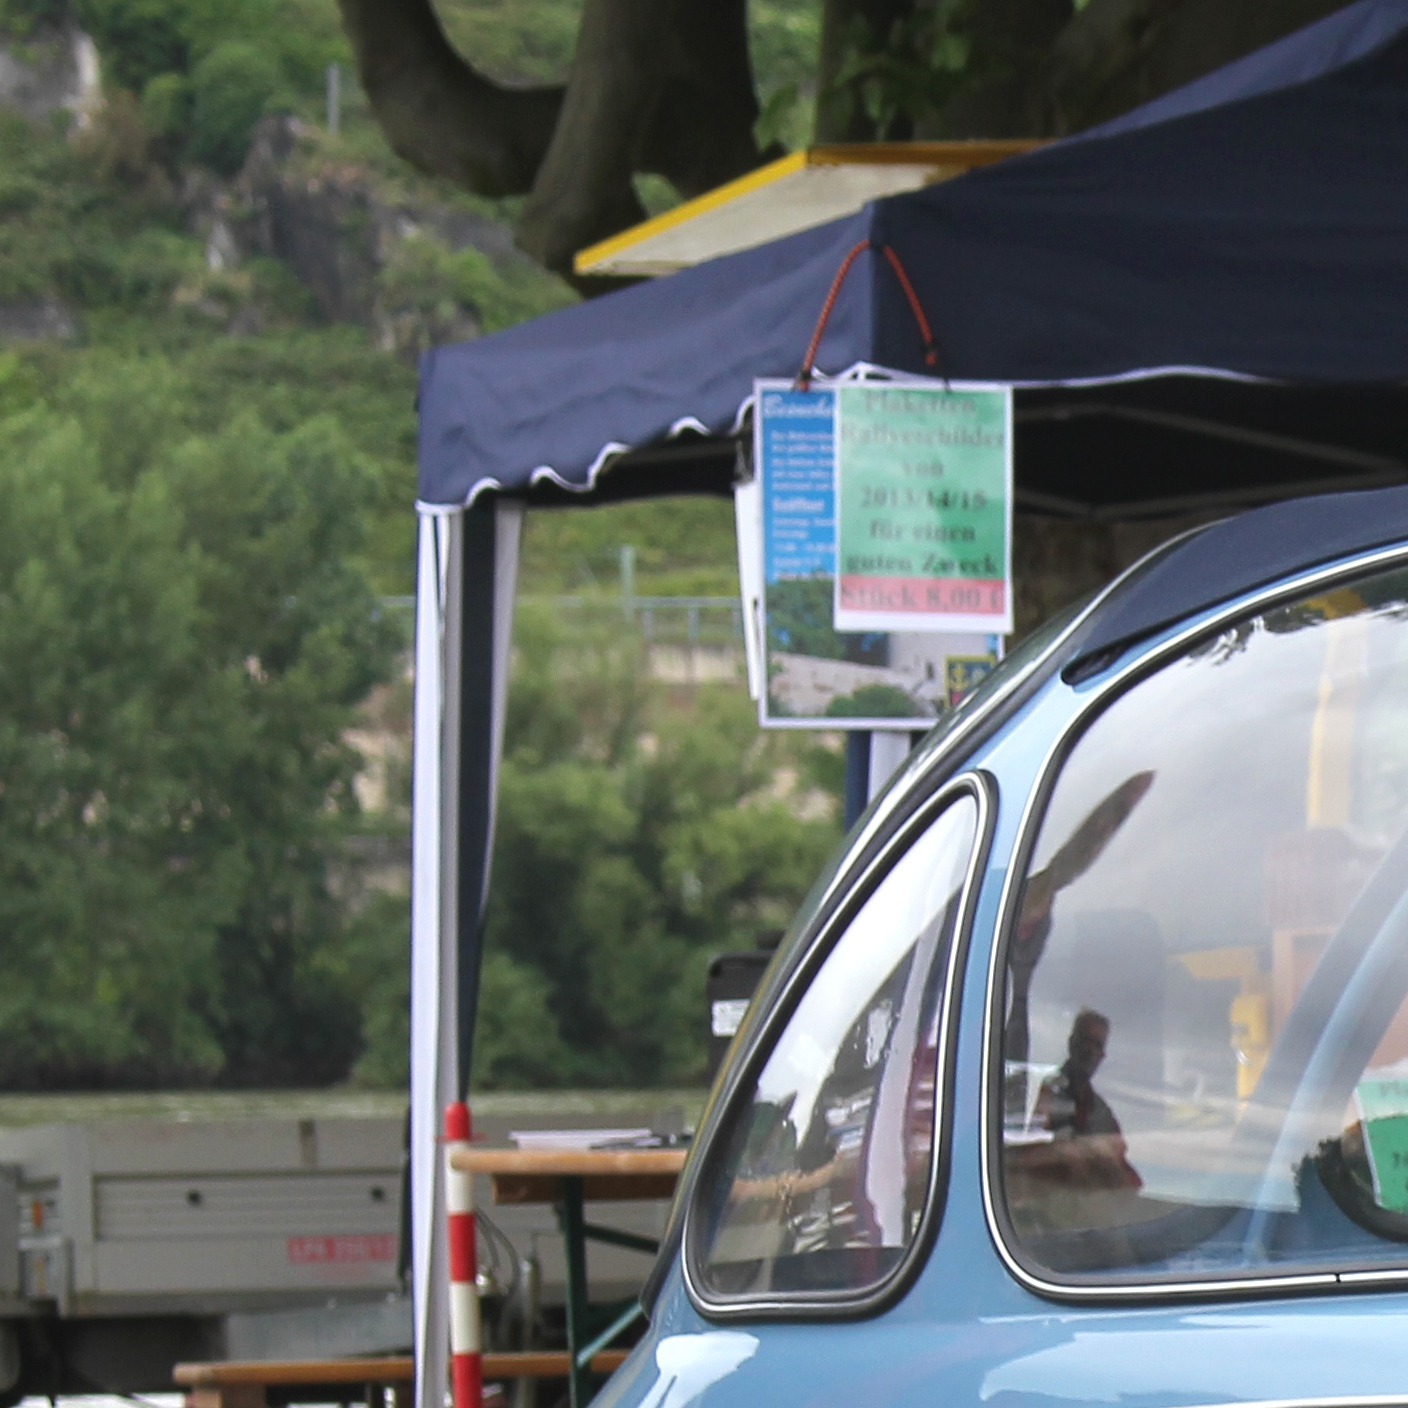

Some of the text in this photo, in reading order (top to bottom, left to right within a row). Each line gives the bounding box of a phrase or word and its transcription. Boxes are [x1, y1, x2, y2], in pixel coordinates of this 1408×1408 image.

[870, 518, 977, 542] für einen
[845, 554, 913, 575] guten
[922, 554, 998, 574] Zweck
[841, 584, 914, 606] Stück
